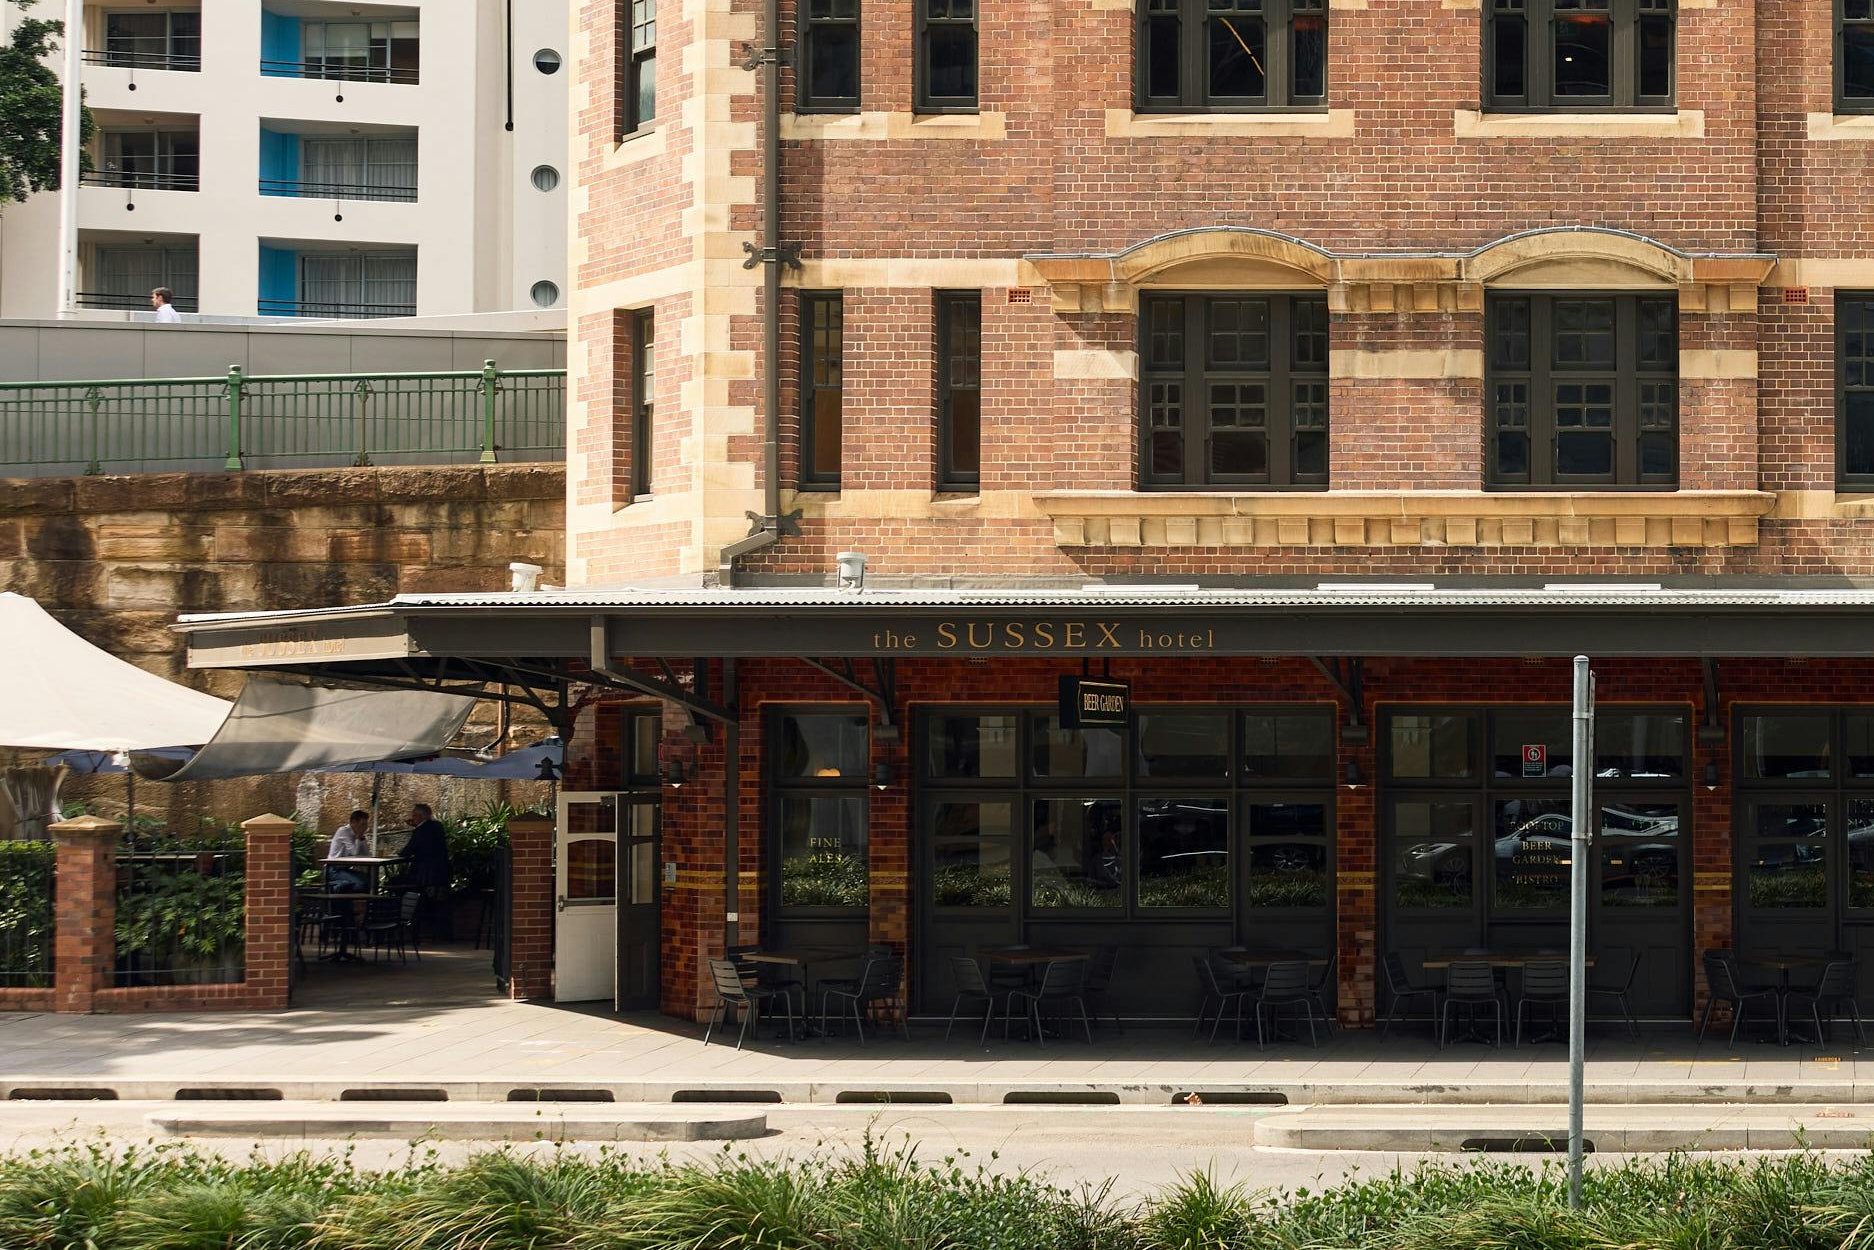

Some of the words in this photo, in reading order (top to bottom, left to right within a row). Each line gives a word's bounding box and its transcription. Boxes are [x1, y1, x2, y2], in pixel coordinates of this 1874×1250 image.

[874, 630, 917, 648] the
[936, 622, 1122, 649] SUSSEX
[1139, 629, 1214, 648] hotel
[1083, 693, 1099, 711] BEER
[1100, 695, 1124, 712] GARDEN
[810, 837, 842, 848] FINE
[1522, 841, 1552, 851] BEER
[809, 853, 844, 864] ALES
[1512, 854, 1562, 864] GARDEN
